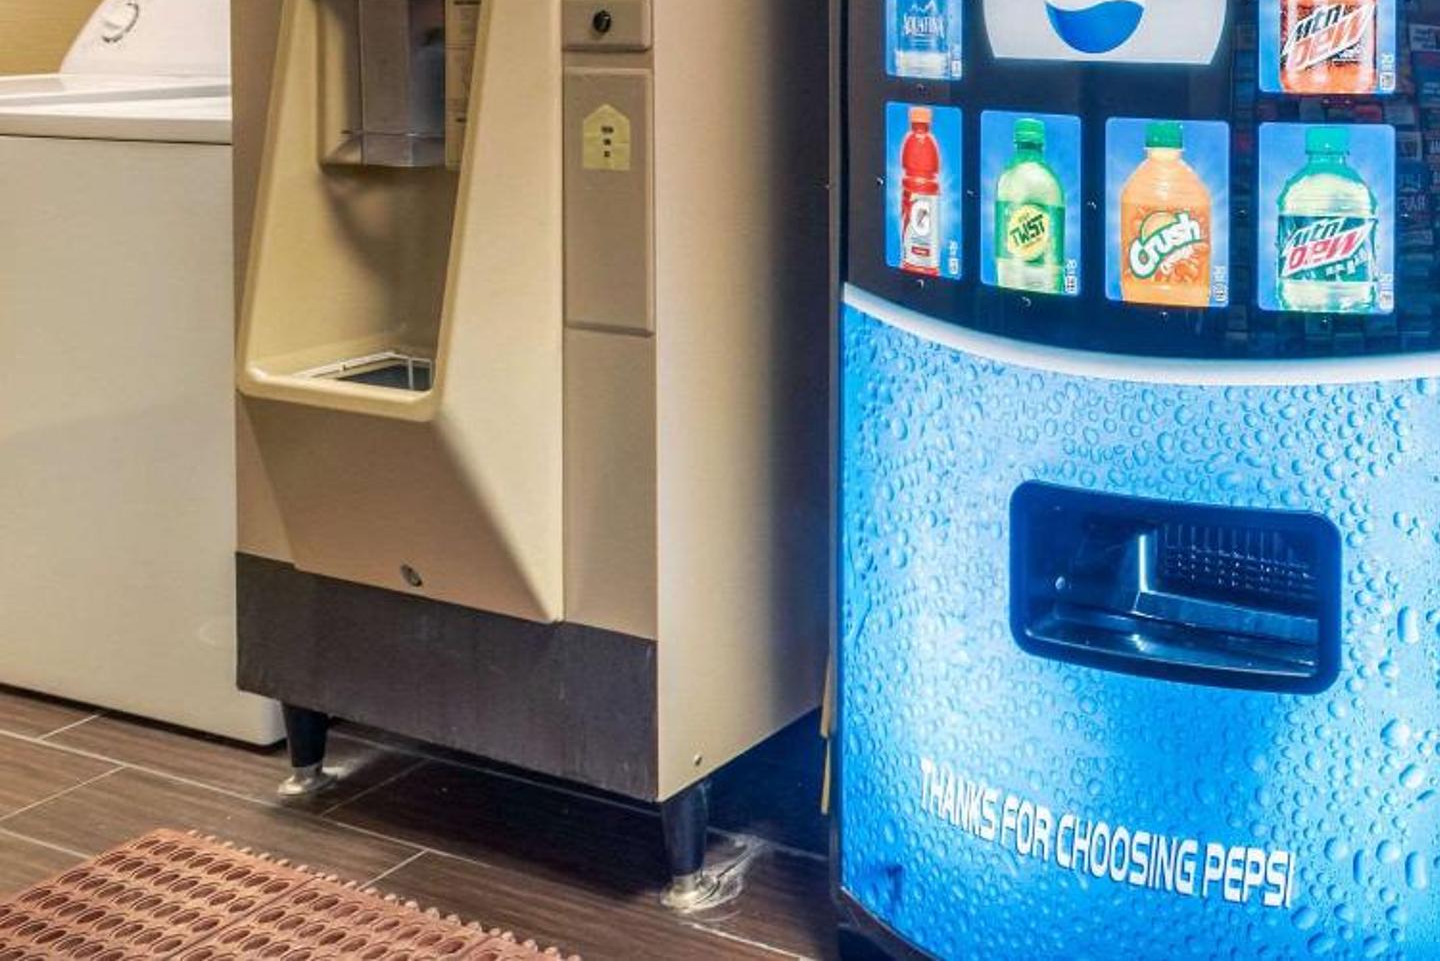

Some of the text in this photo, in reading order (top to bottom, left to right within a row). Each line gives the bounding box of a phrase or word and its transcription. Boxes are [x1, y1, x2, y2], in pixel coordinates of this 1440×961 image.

[1129, 211, 1202, 279] Crush
[920, 758, 1298, 908] THANKS FOR CHOOSING PEPSI
